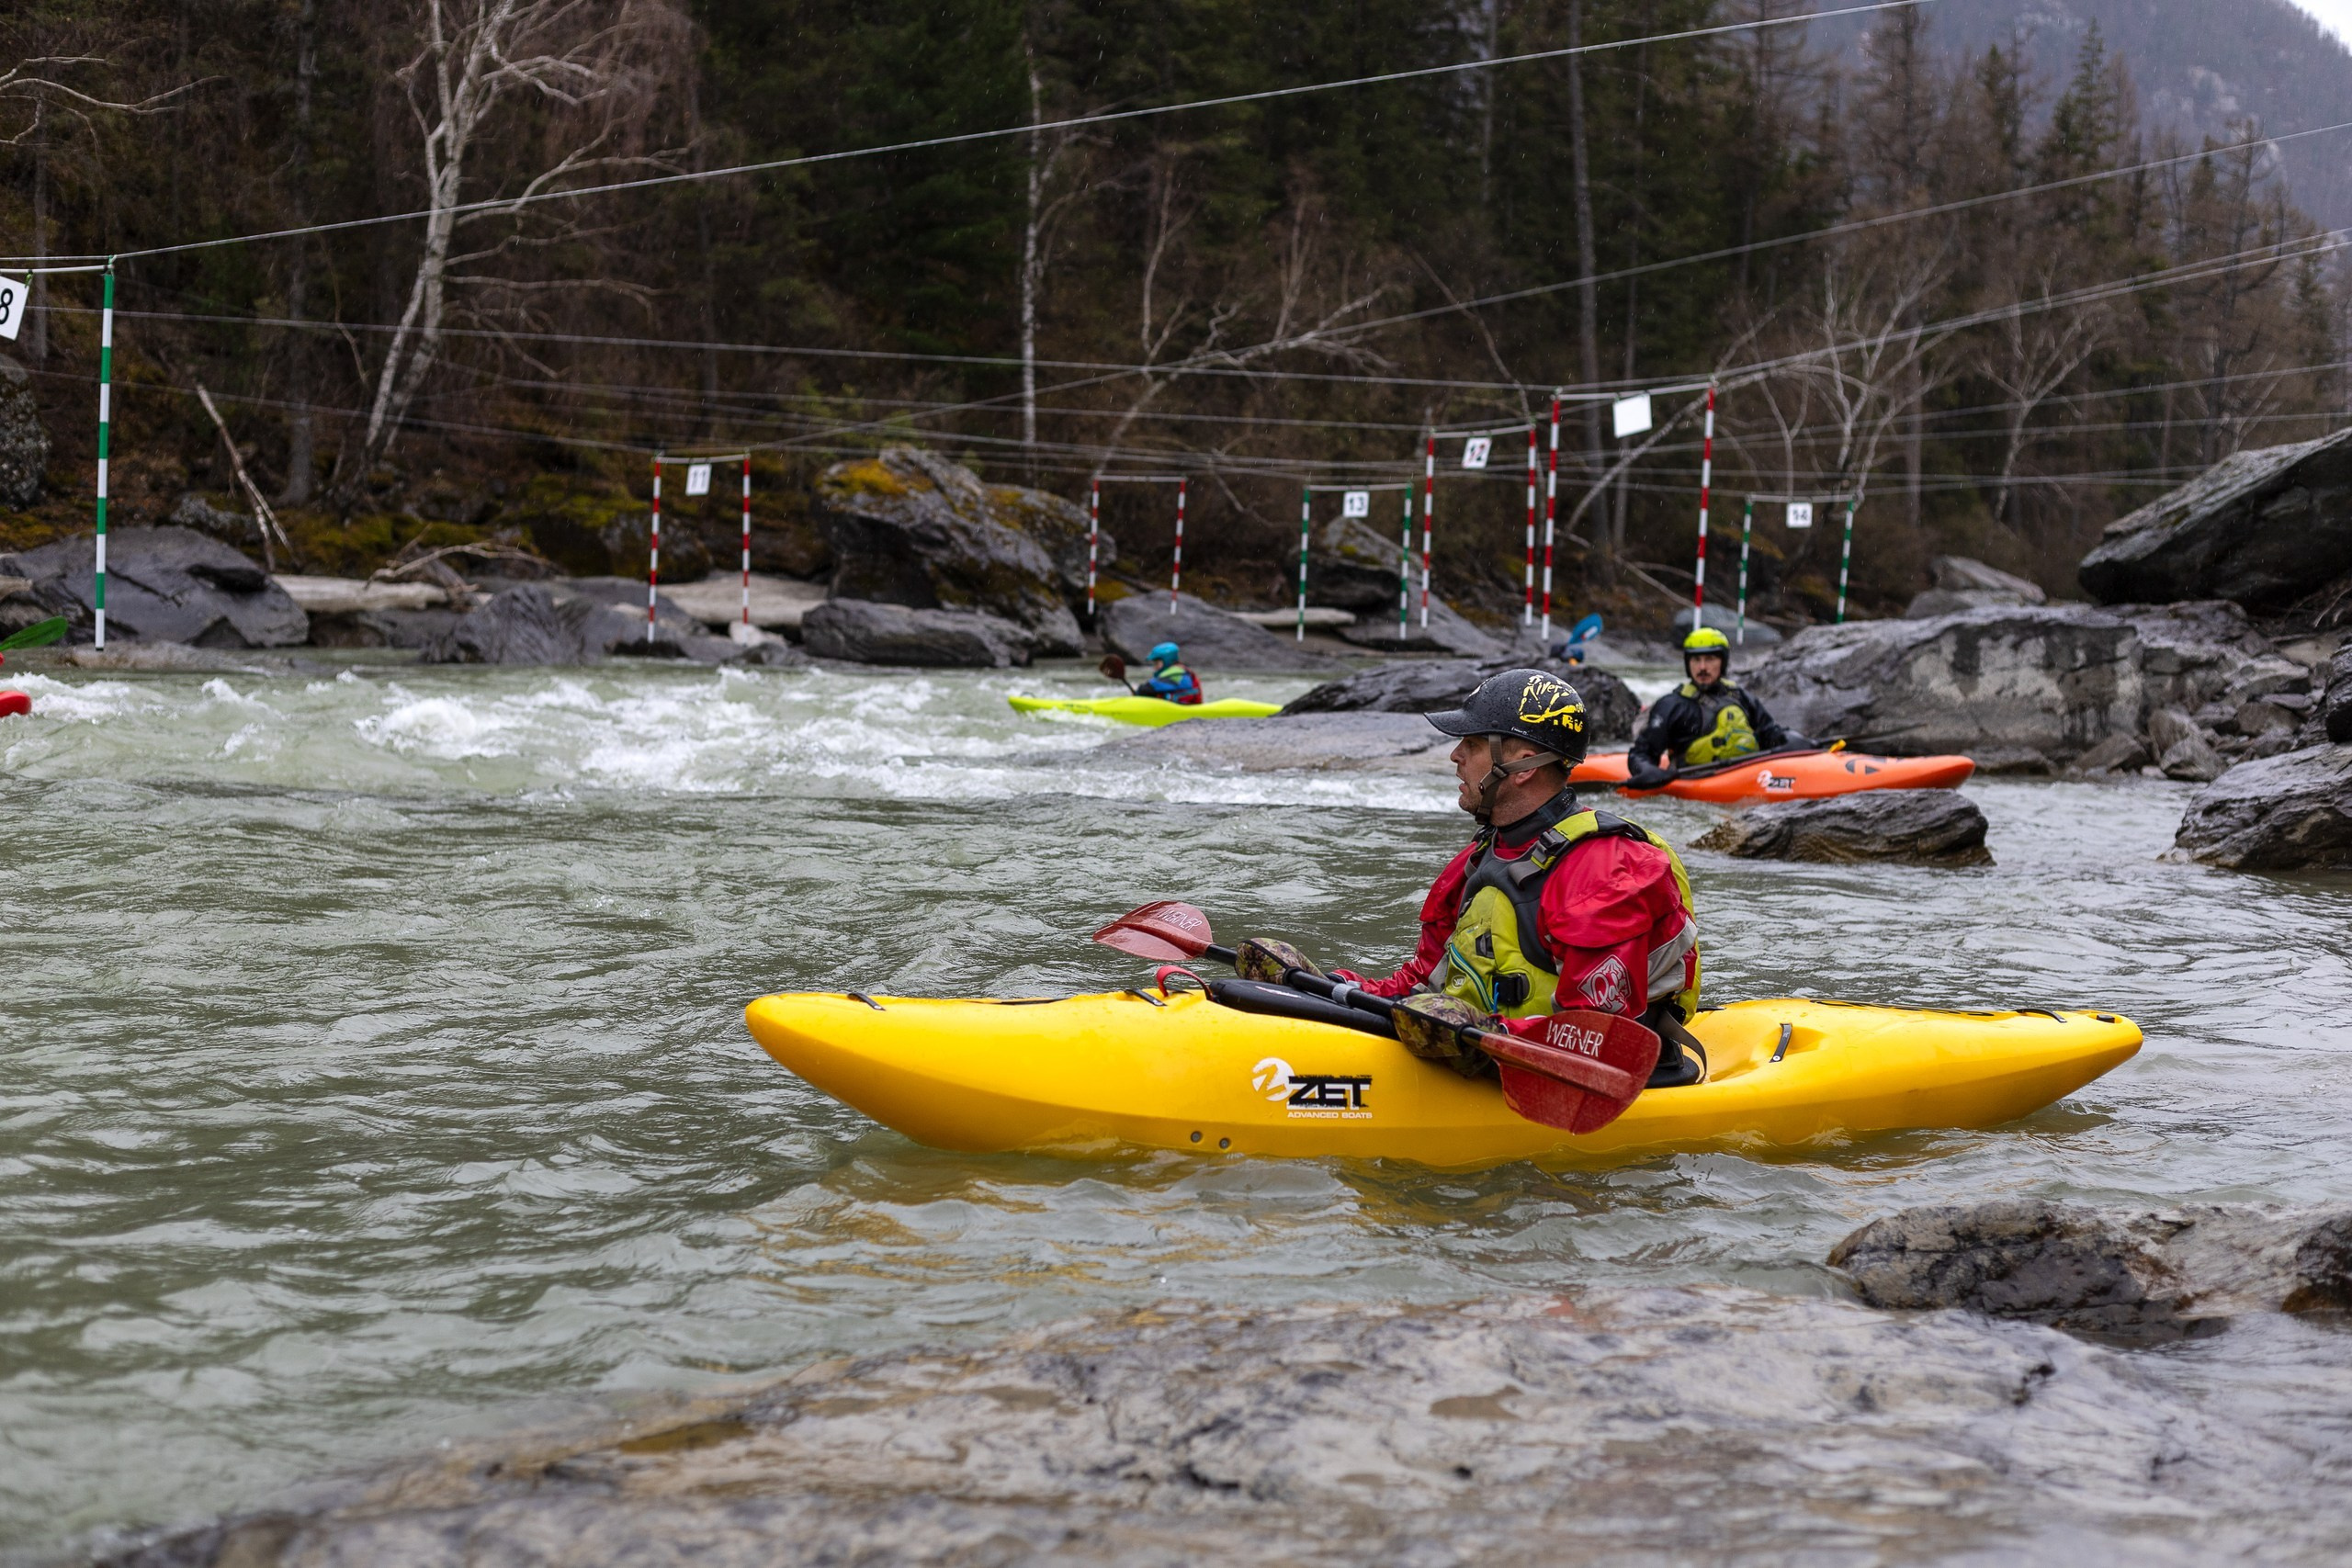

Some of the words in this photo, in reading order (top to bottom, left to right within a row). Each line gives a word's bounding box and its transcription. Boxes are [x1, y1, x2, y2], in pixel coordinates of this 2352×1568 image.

[0, 288, 14, 325] 8
[691, 469, 707, 490] 11
[1348, 496, 1365, 512] 13
[1157, 908, 1203, 931] WERNER
[1545, 1020, 1604, 1057] WERNER
[1287, 1074, 1373, 1110] ZET
[1287, 1111, 1340, 1119] ADVANCED
[1341, 1111, 1374, 1120] BOATS
